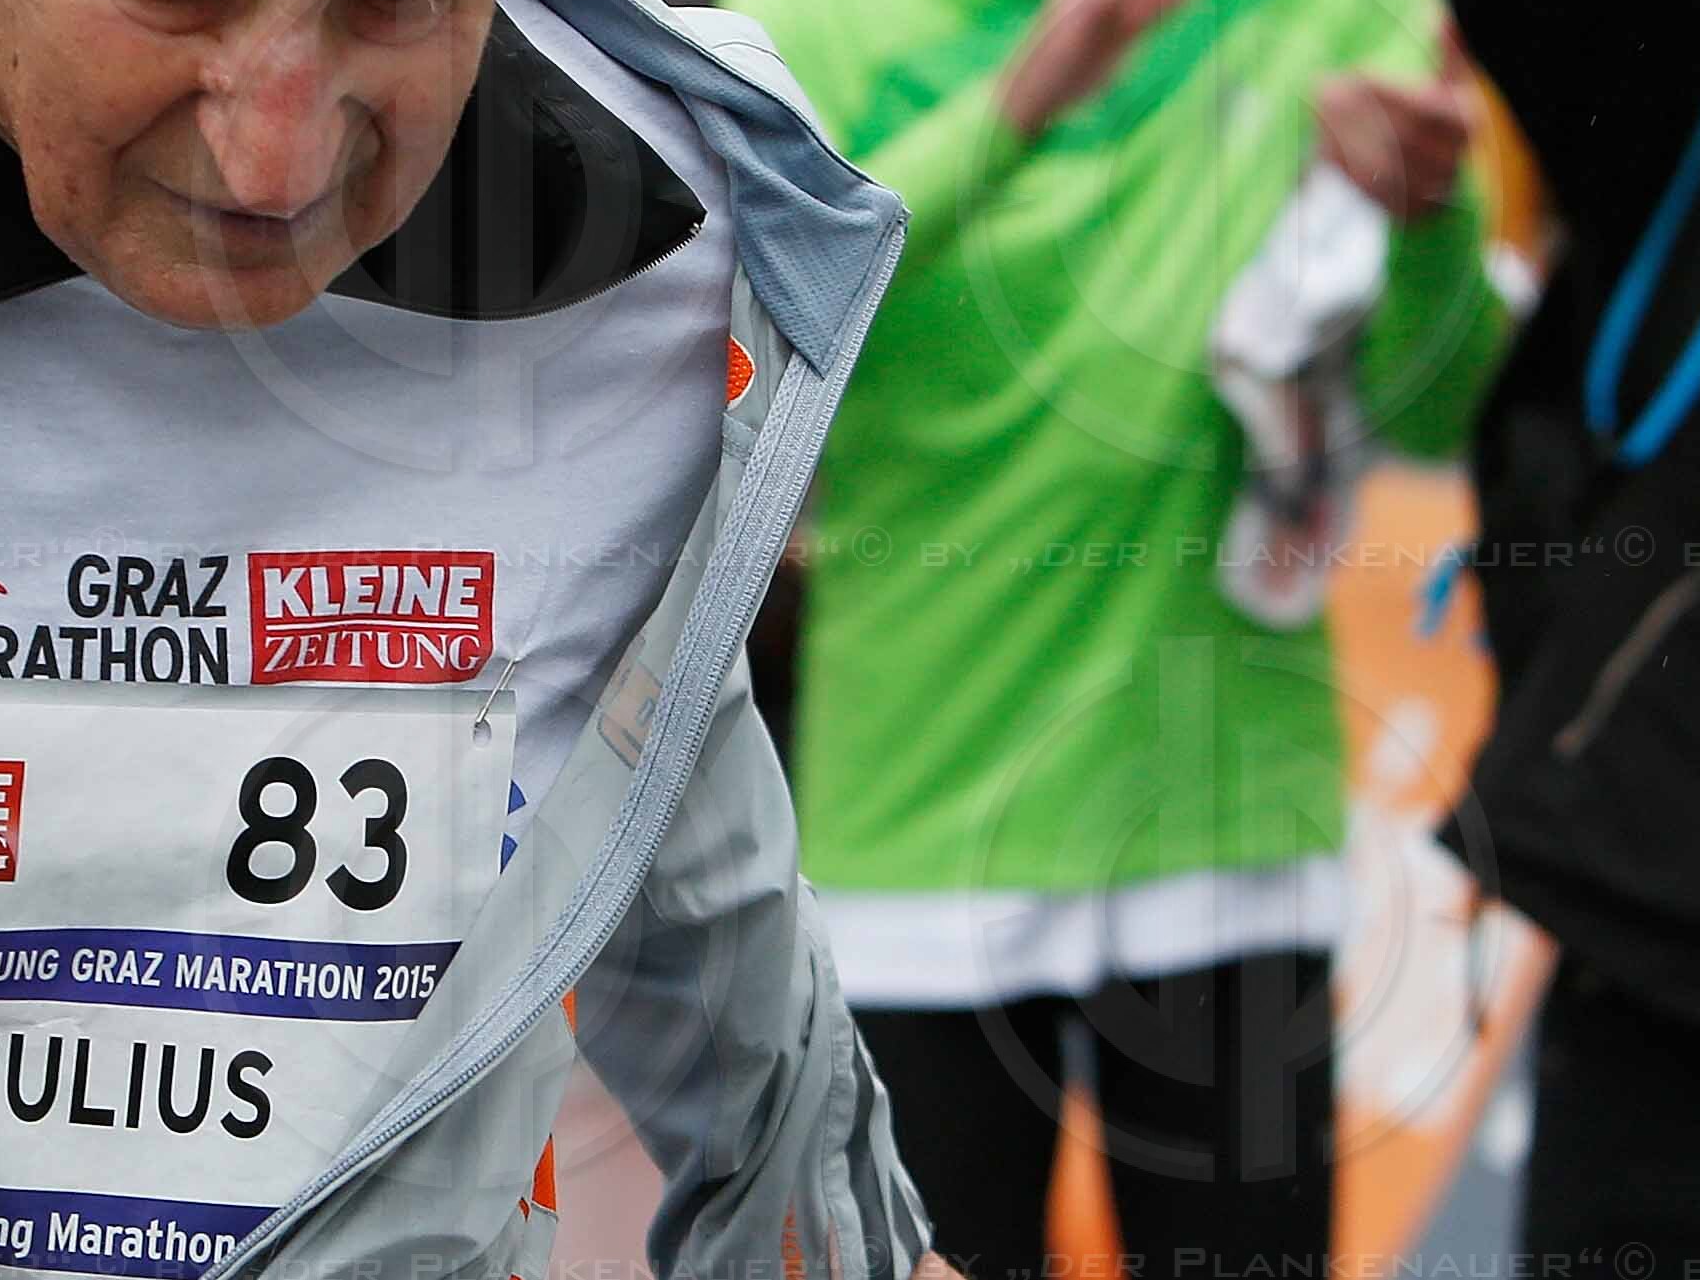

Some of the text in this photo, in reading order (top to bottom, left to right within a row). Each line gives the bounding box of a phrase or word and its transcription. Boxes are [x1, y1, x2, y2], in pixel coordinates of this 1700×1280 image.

[67, 554, 229, 618] GRAZ
[263, 566, 482, 618] KLEINE
[263, 631, 481, 672] ZEITUNG
[226, 756, 408, 911] 83
[71, 947, 162, 988] GRAZ
[174, 954, 365, 1001] MARATHON
[372, 964, 438, 1000] 2015
[47, 1211, 237, 1265] Marathon
